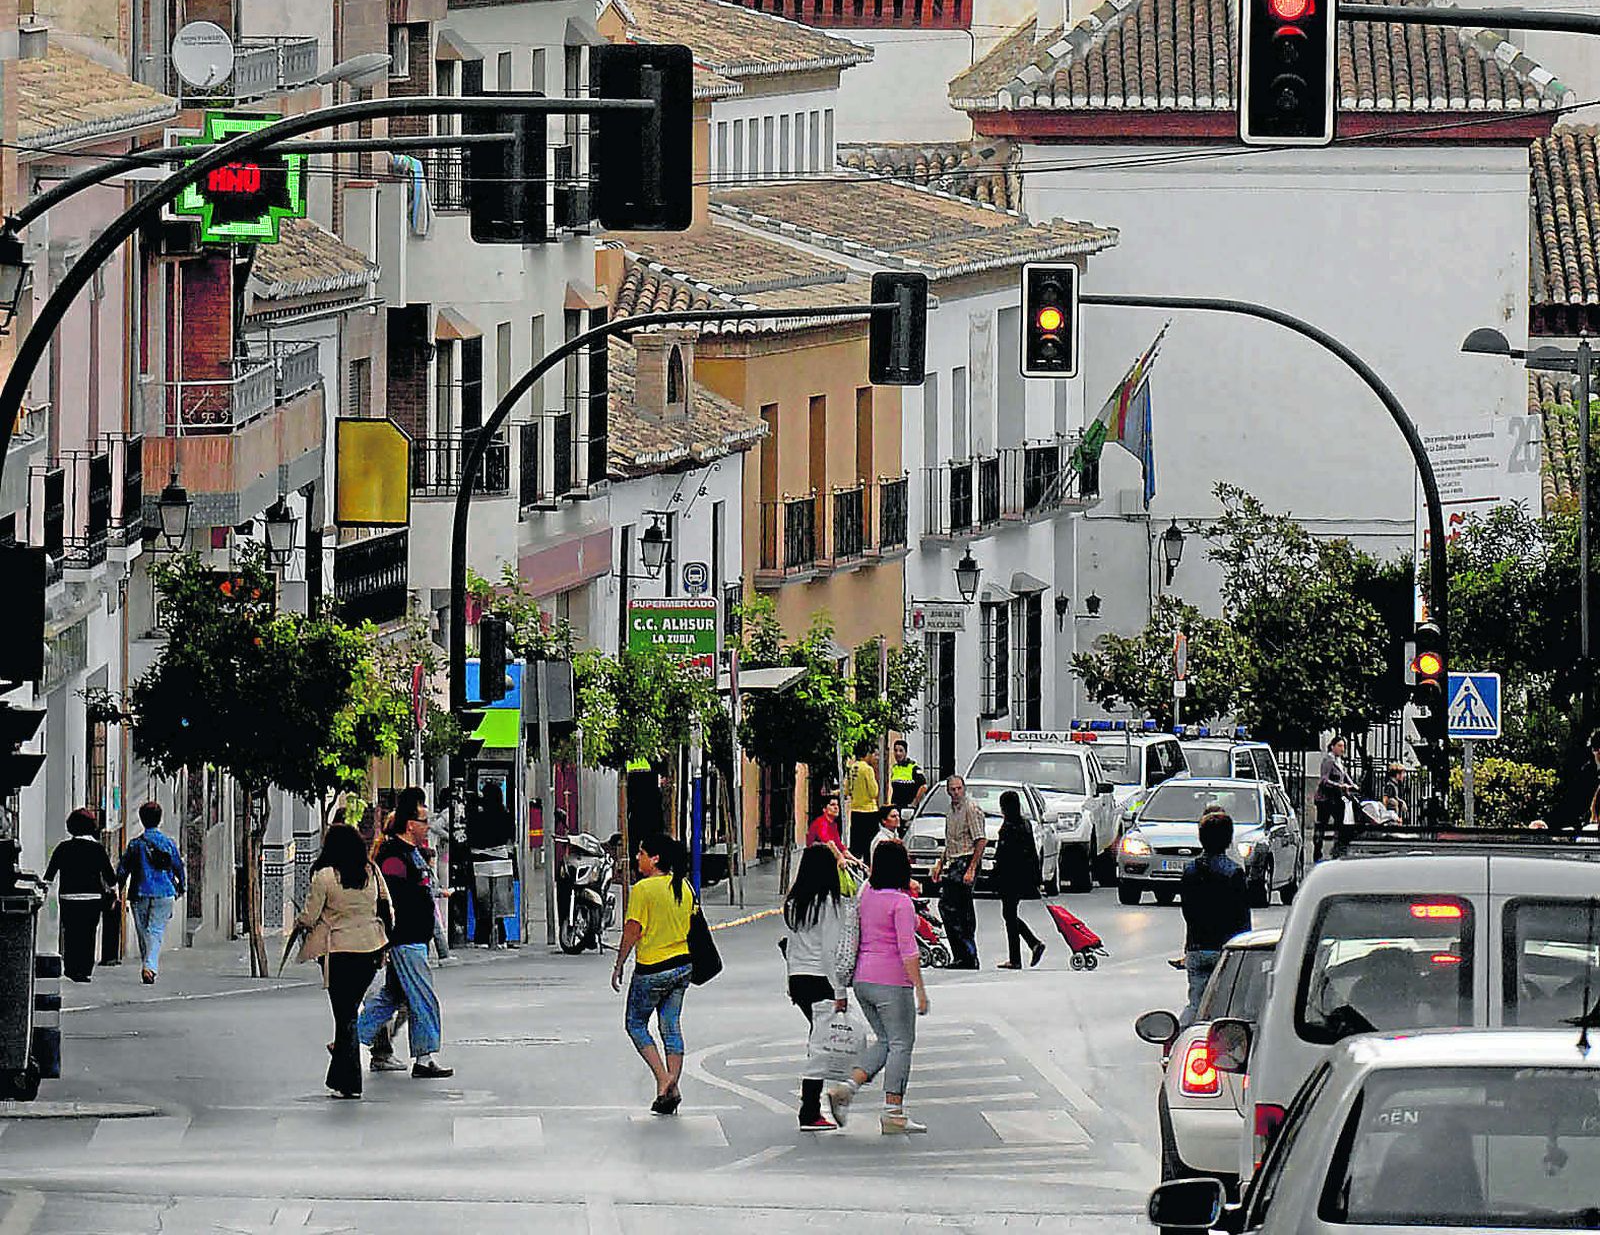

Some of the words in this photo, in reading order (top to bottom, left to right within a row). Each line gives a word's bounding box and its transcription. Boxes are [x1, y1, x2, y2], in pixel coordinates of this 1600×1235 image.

[632, 600, 715, 608] SUPERMERCADO
[633, 618, 658, 631] C.C.
[662, 618, 714, 631] ALHSUR
[652, 634, 665, 644] LA
[667, 634, 696, 644] ZUBIA
[1017, 732, 1059, 741] GRUA
